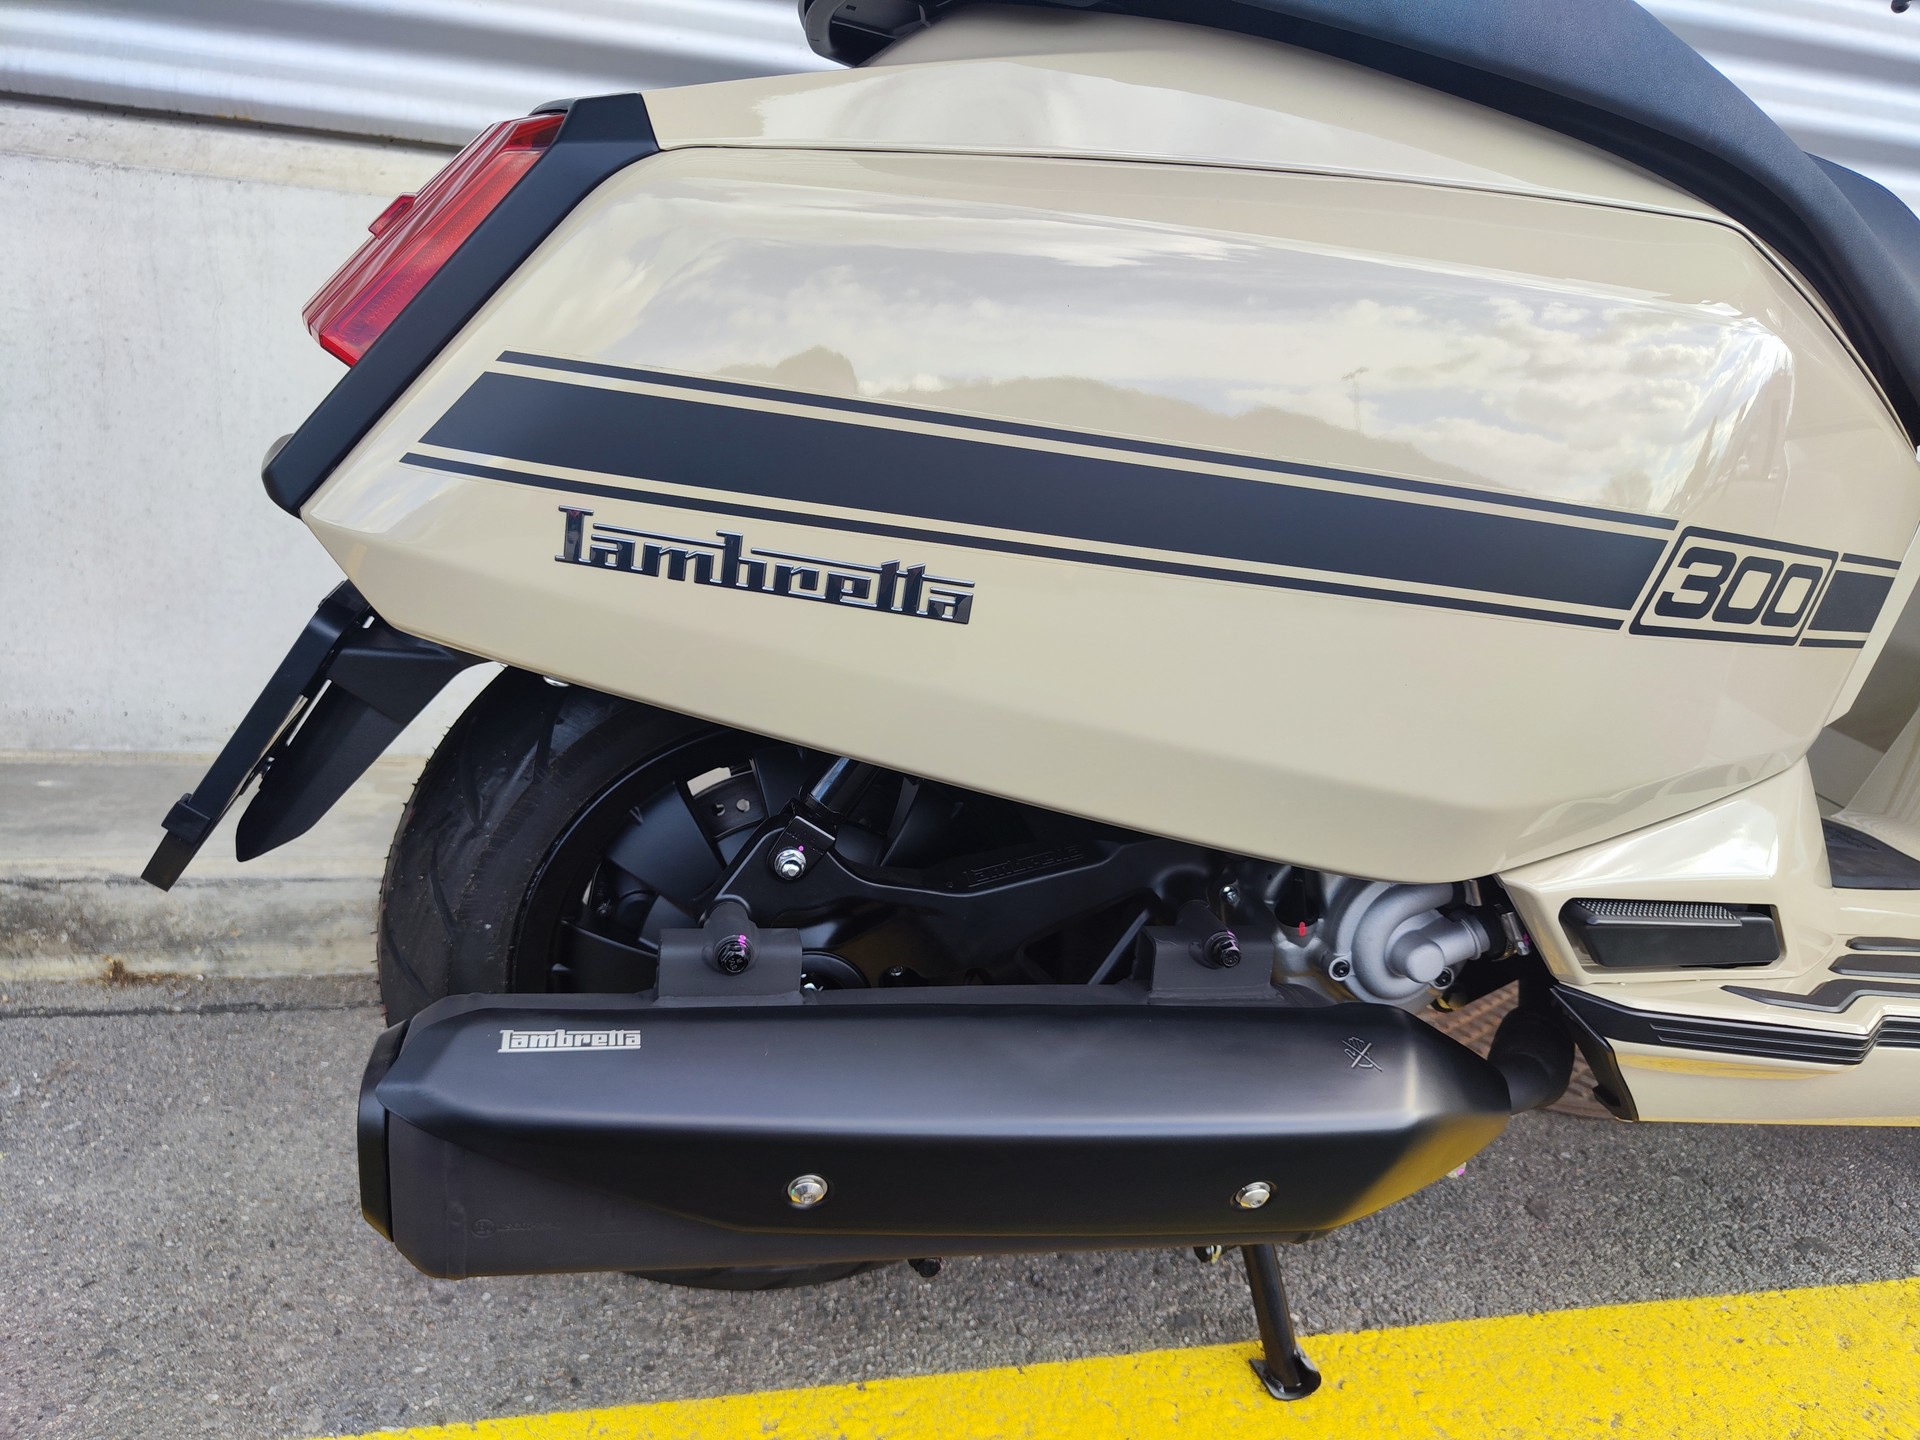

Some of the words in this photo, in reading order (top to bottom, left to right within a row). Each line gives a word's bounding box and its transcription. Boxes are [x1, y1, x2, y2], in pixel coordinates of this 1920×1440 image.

[554, 505, 975, 624] Lambretta
[1654, 546, 1823, 628] 300
[498, 1029, 641, 1053] Lambretta
